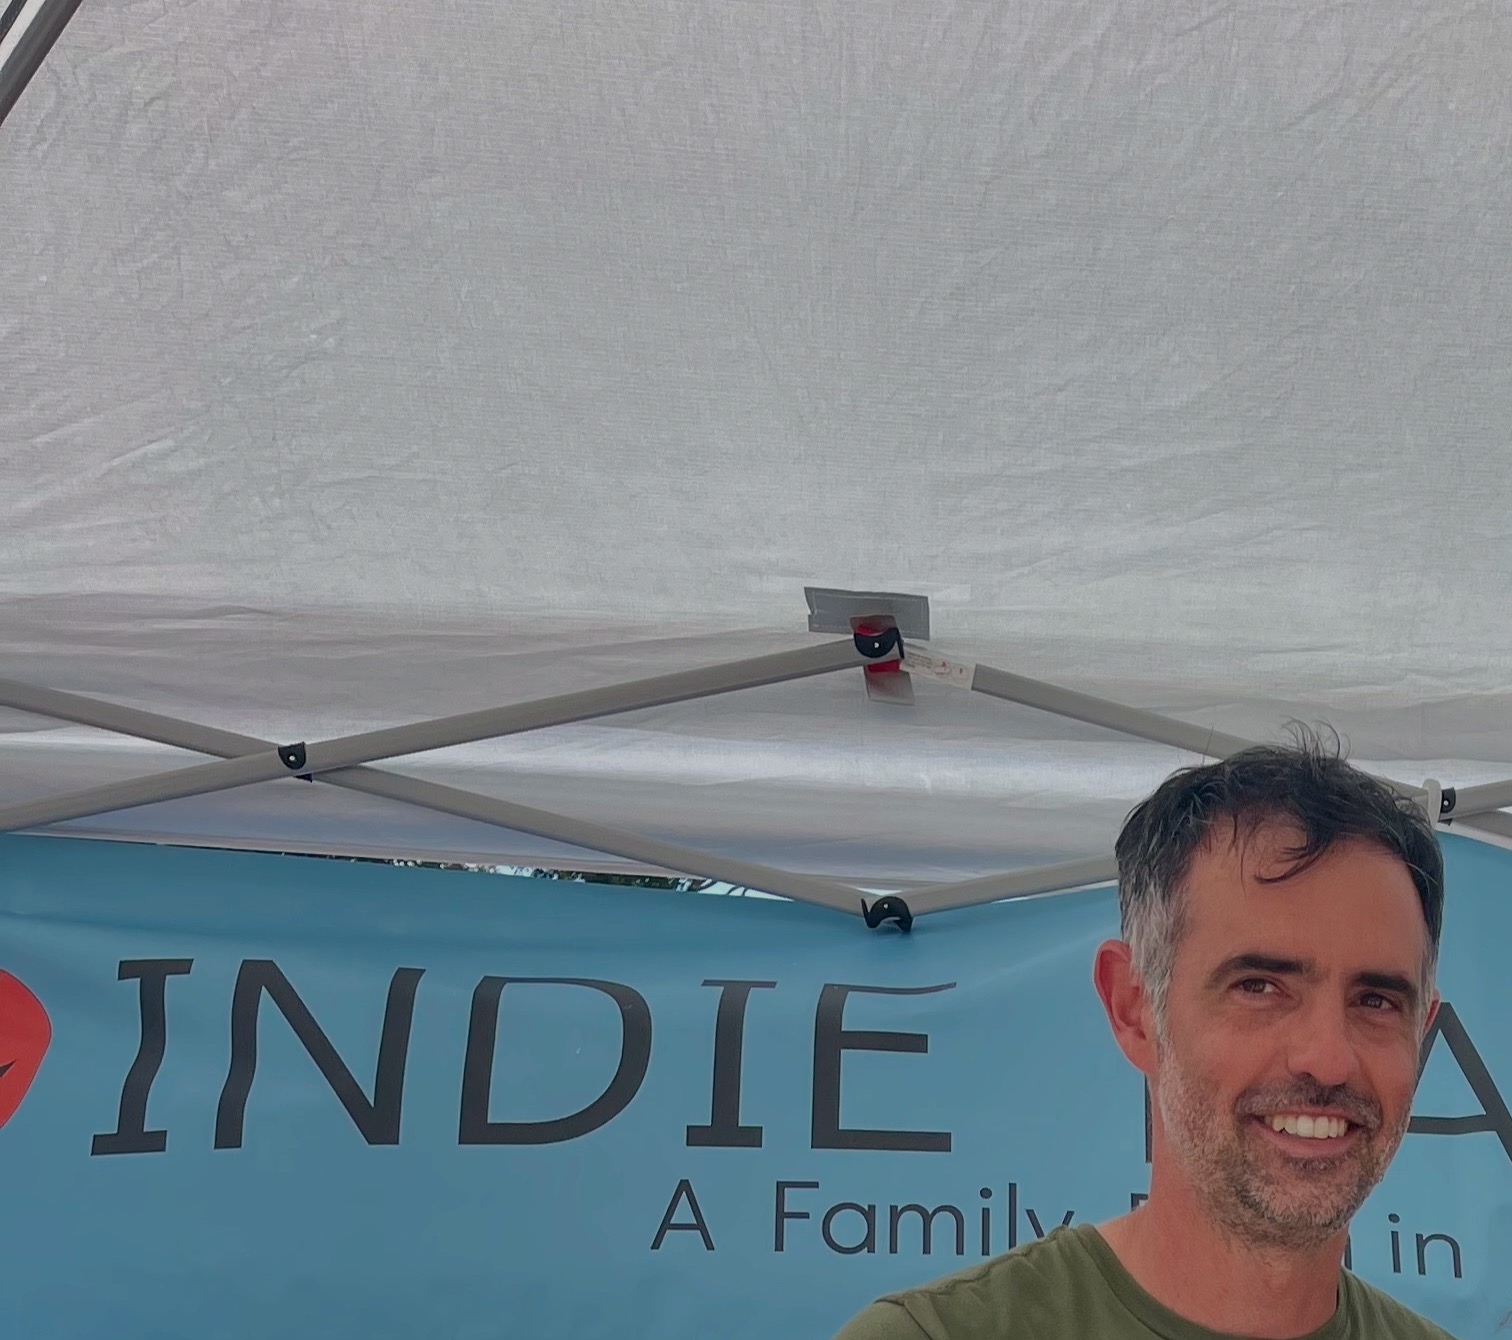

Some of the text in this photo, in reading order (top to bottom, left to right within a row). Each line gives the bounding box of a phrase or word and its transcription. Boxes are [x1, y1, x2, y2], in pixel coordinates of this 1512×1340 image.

[91, 958, 958, 1155] INDIE
[650, 1179, 715, 1251] A
[1388, 1213, 1463, 1279] in
